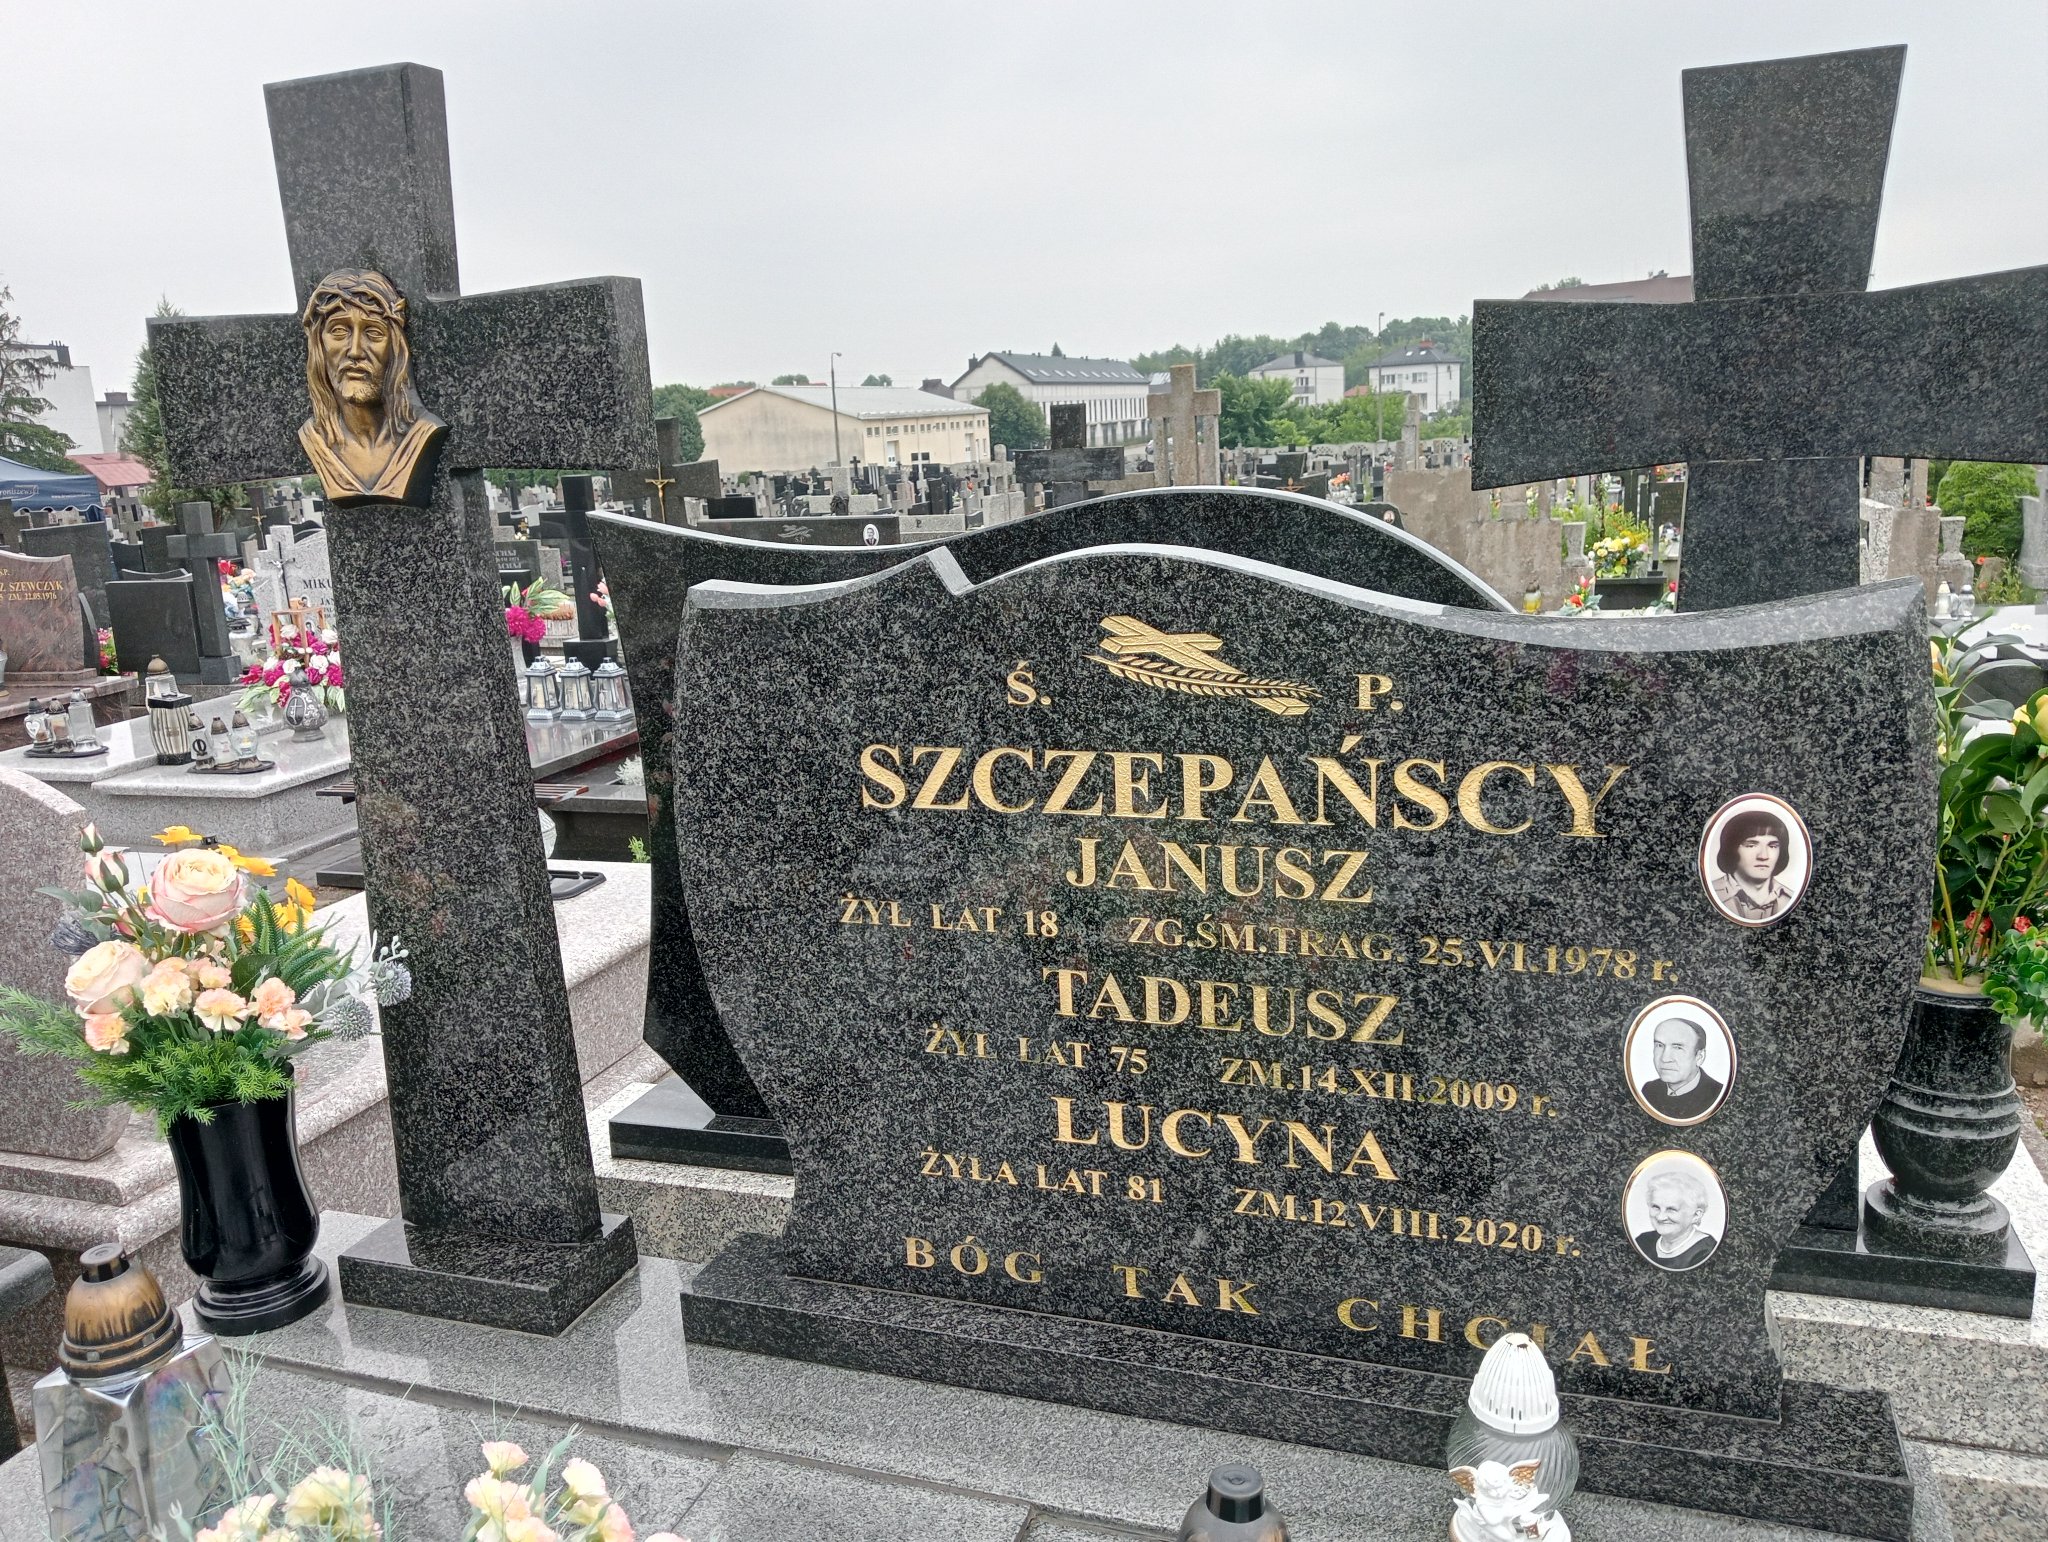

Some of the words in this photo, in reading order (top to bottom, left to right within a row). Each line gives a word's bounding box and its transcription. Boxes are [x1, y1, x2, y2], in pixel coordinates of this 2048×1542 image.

[9, 581, 64, 591] SZEWCZYK
[1007, 661, 1052, 706] Ś.
[1353, 673, 1404, 711] P.
[859, 735, 1629, 838] SZCZEPAŃSCY
[1066, 837, 1375, 904] JANUSZ
[840, 893, 911, 928] ŻYŁ
[930, 903, 1002, 933] LAT
[1022, 910, 1058, 937] 18
[1418, 935, 1637, 979] 25.VI.1978
[1042, 966, 1405, 1046] TADEUSZ
[924, 1022, 998, 1060] ŻYŁ
[1018, 1037, 1092, 1069] LAT
[1110, 1045, 1149, 1075] 75
[919, 1145, 1019, 1186] ŻYŁA
[1036, 1164, 1108, 1196] LAT
[1127, 1175, 1163, 1203] 81
[1050, 1096, 1400, 1181] LUCYNA
[903, 1235, 1044, 1284] BÓG
[1112, 1264, 1260, 1315] TAK
[1336, 1297, 1672, 1374] CHCIAŁ
